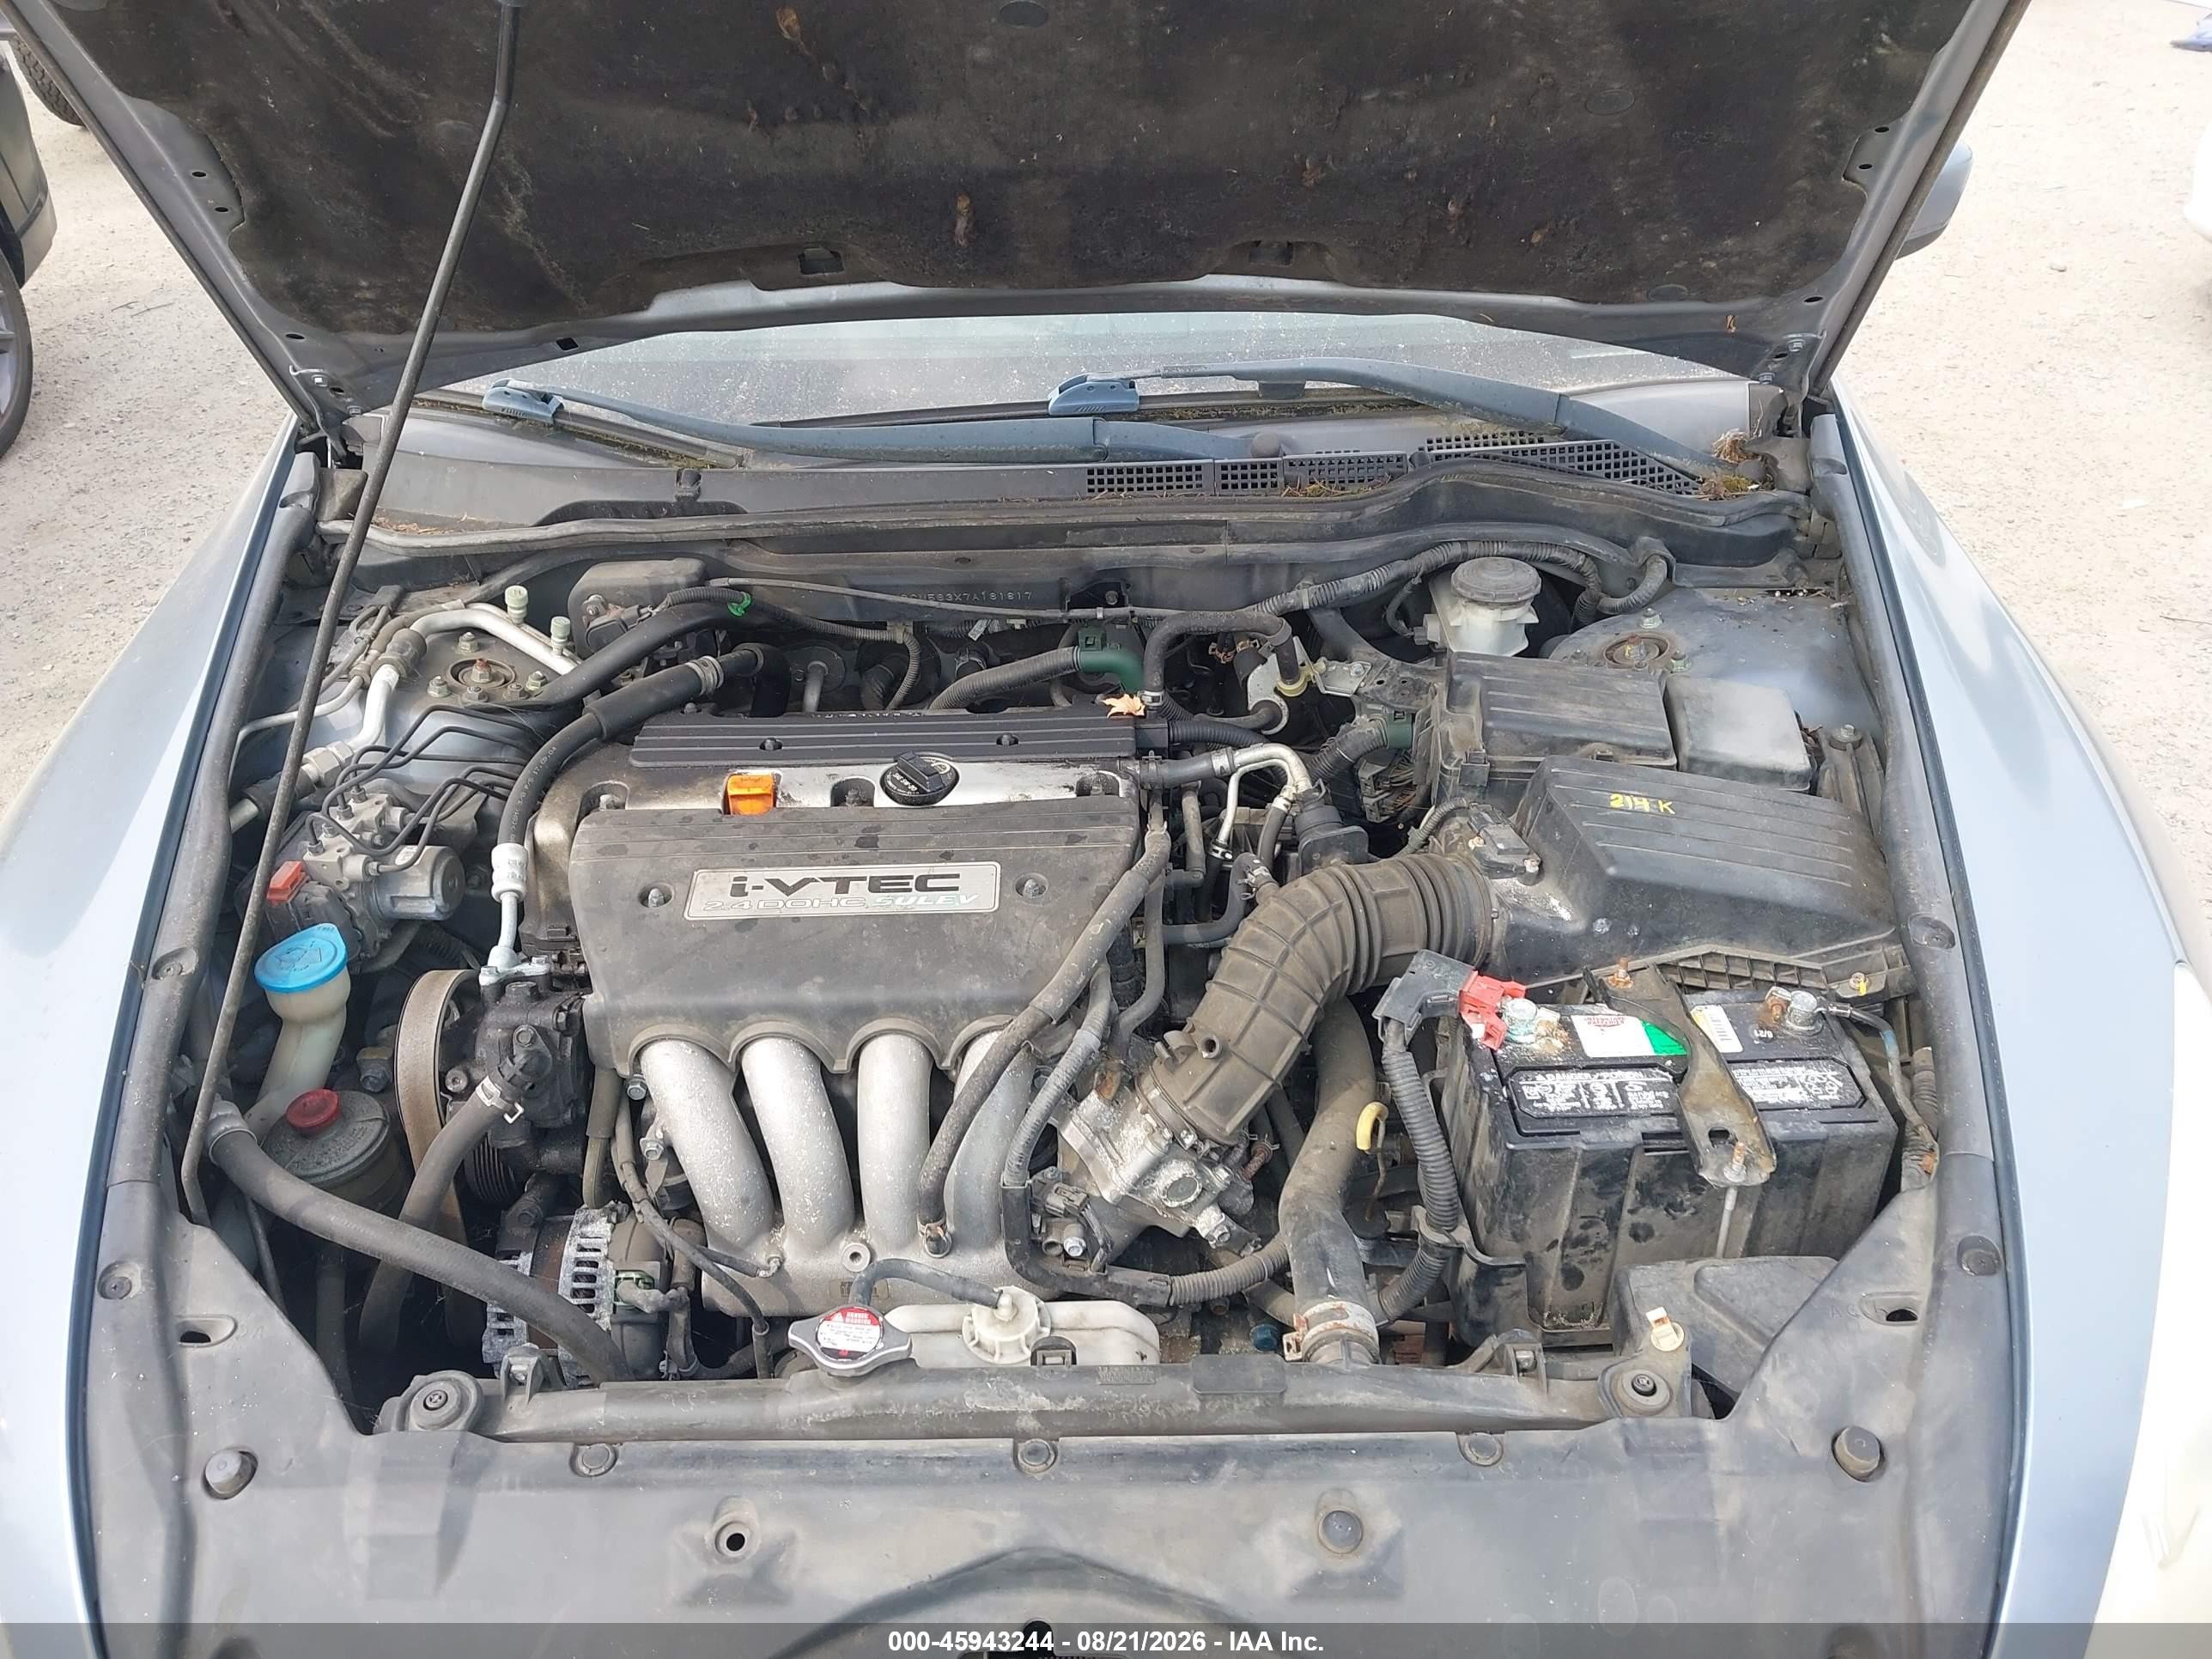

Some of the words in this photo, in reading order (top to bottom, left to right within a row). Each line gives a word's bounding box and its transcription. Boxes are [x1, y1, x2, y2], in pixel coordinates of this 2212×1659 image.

[1609, 793, 1650, 812] 214
[1657, 799, 1676, 815] K
[730, 872, 961, 898] i-VTEC
[702, 900, 752, 912] 2.4
[757, 896, 867, 909] DOHC
[871, 893, 981, 908] SULEV
